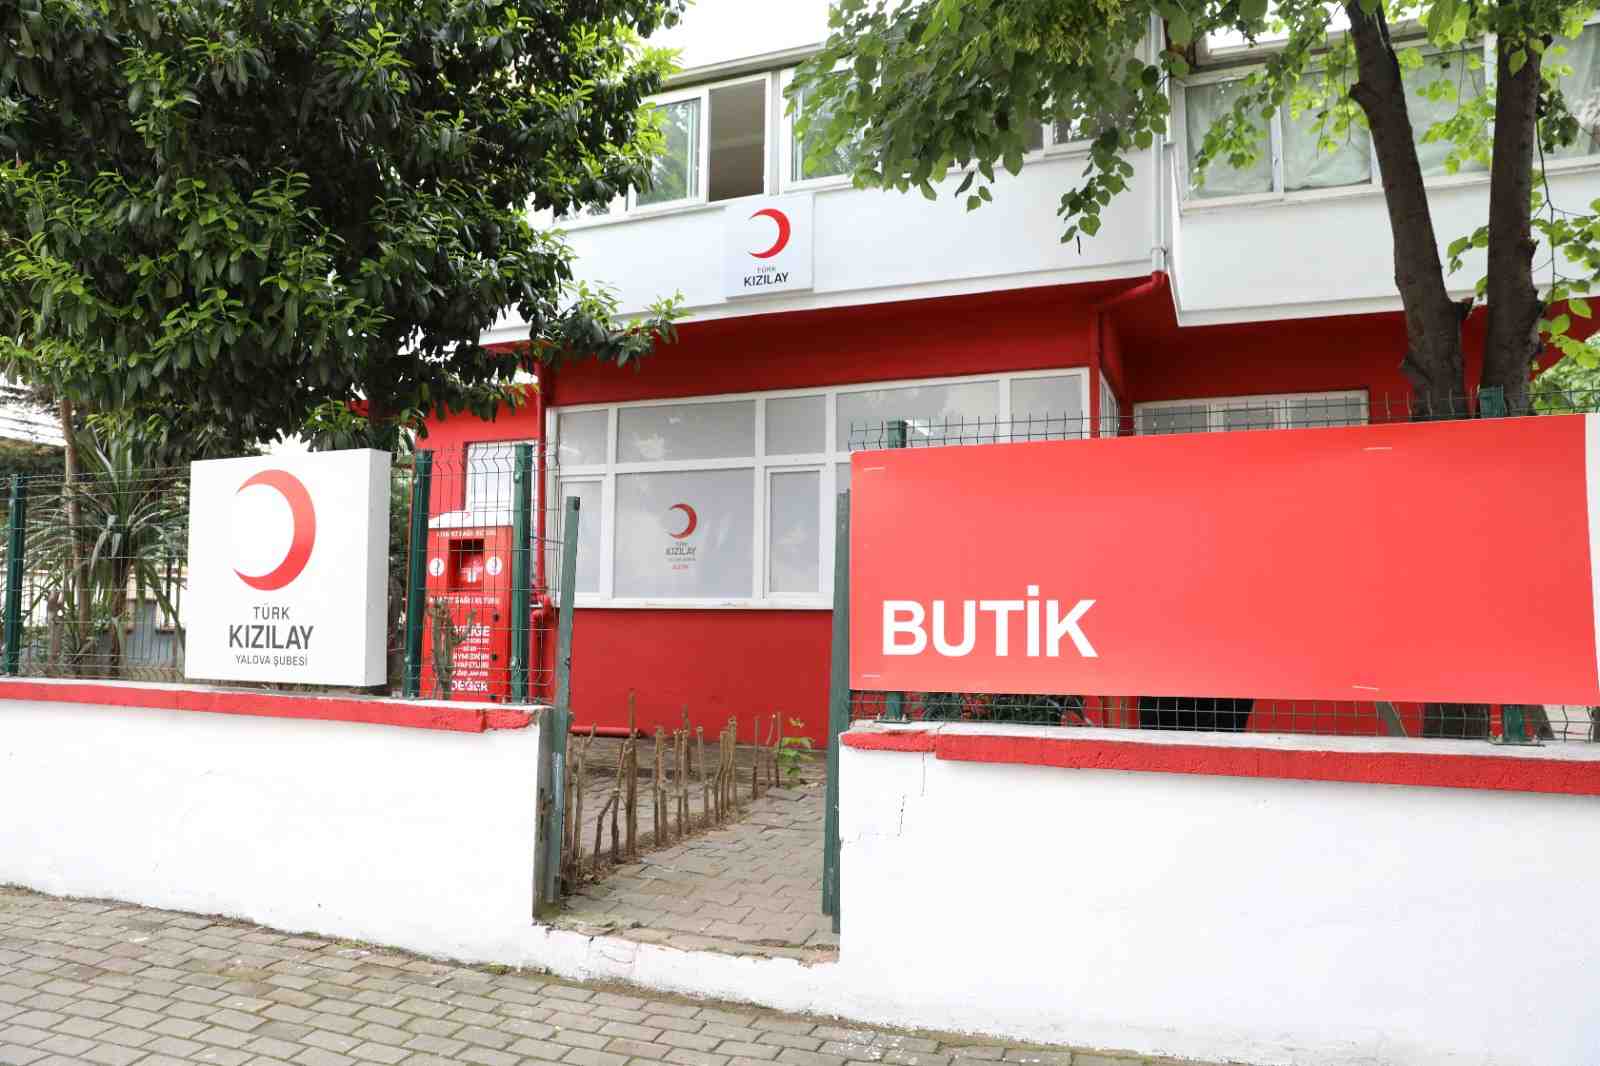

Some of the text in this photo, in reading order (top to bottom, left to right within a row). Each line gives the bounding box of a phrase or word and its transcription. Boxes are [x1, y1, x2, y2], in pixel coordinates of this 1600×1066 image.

[743, 271, 789, 288] KIZILAY
[253, 602, 291, 620] TÜRK
[881, 584, 1098, 659] BUTİK
[229, 624, 314, 650] KIZILAY
[235, 654, 308, 668] YALOVA ŞUBESİ
